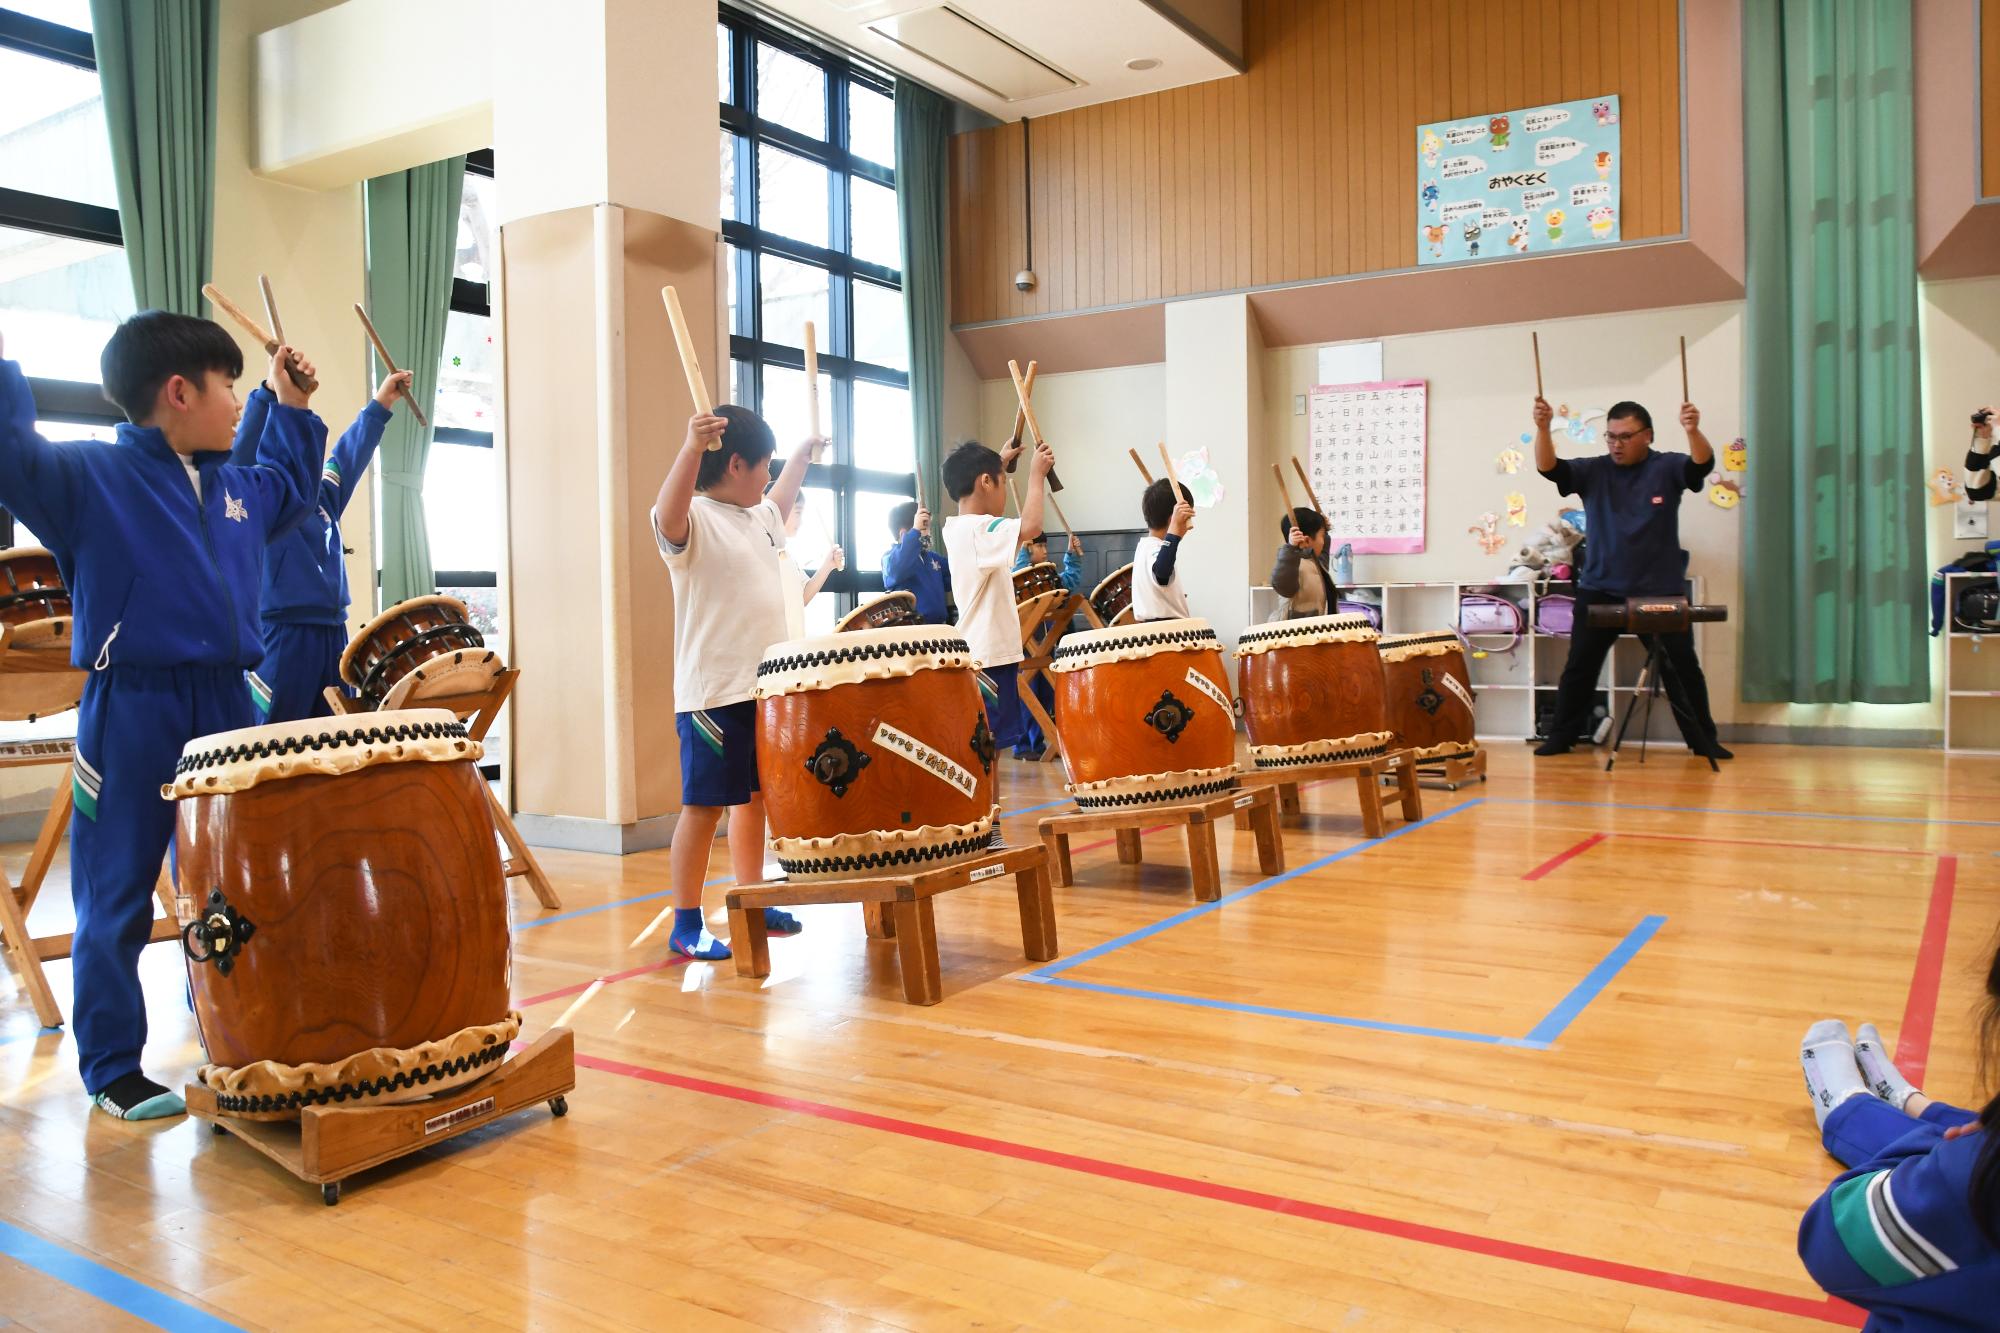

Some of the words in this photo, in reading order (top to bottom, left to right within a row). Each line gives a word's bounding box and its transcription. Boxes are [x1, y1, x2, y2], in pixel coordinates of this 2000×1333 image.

[1488, 171, 1548, 190] おやくそく
